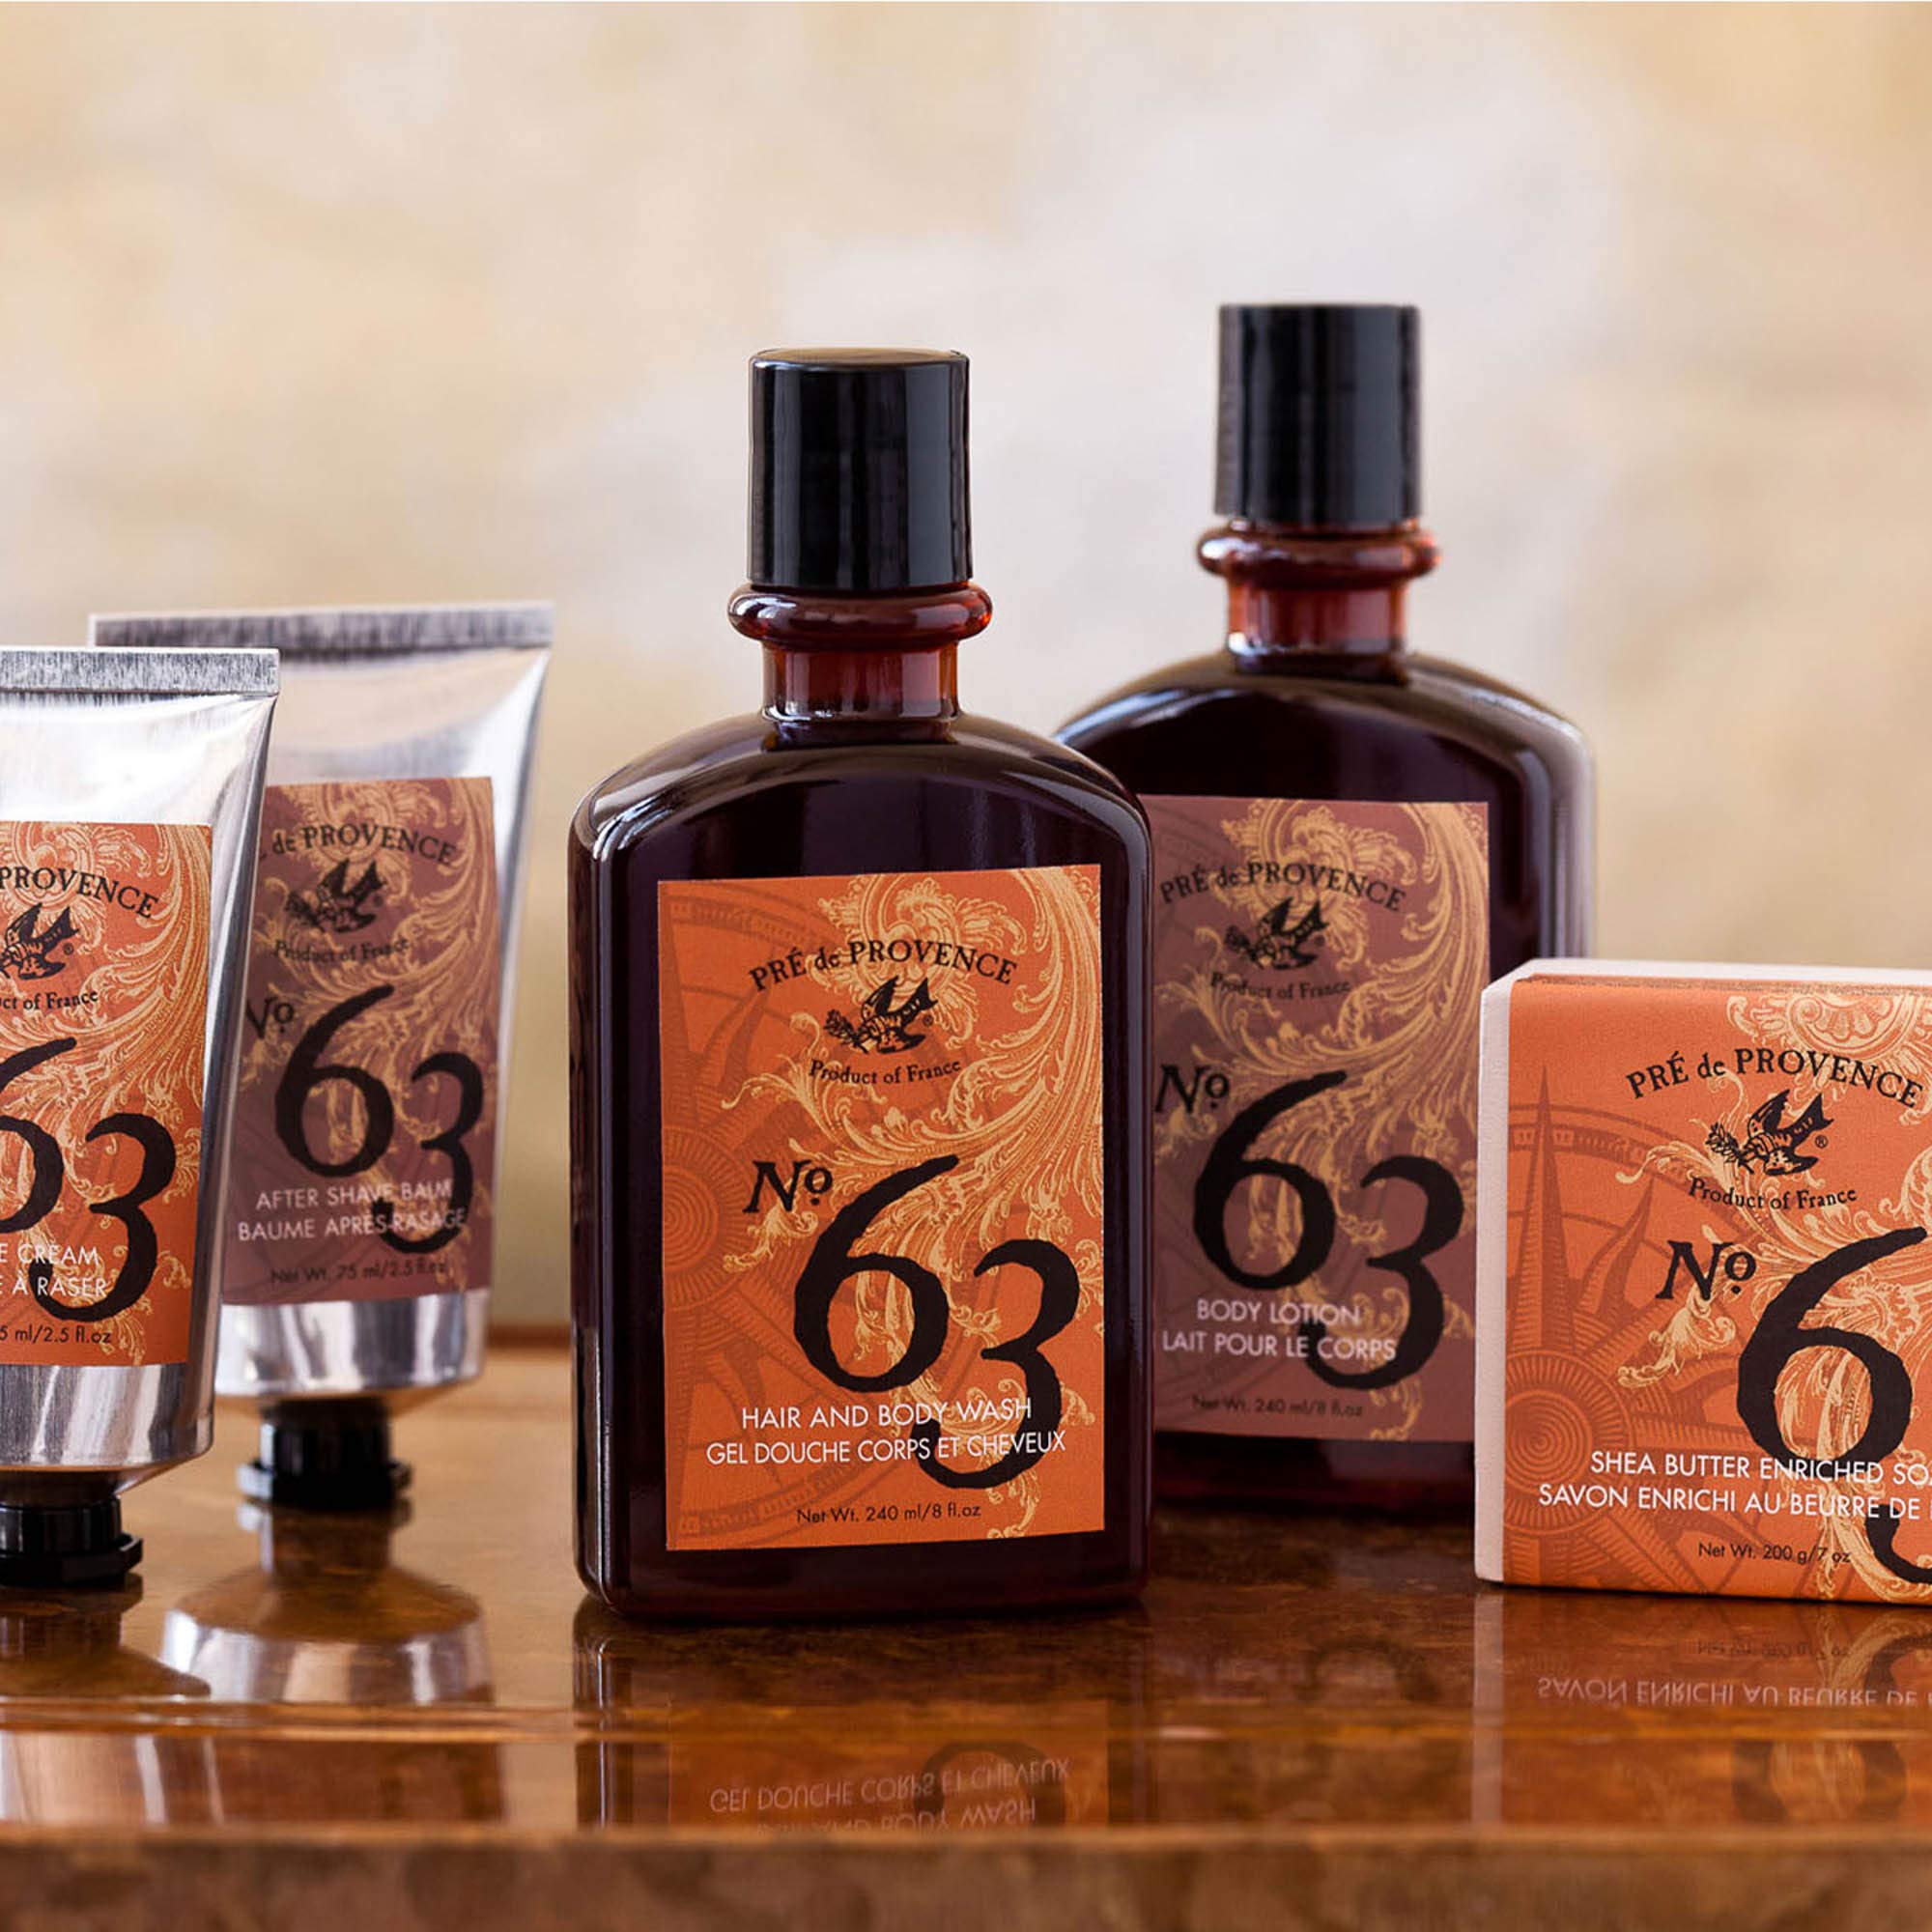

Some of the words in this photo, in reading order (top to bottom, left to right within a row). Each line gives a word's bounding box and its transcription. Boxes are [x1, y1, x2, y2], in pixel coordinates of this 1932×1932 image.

[271, 832, 296, 855] de
[302, 823, 458, 865] PROVENCE
[0, 867, 158, 919] PROVENCE
[1160, 864, 1208, 904] PRÉ
[1216, 867, 1239, 889] de
[1246, 860, 1407, 912] PROVENCE
[749, 948, 807, 992] PRÉ
[813, 947, 841, 971] de
[848, 939, 1018, 985] PROVENCE
[23, 992, 42, 1010] of
[46, 990, 99, 1009] France
[1210, 972, 1272, 1000] Product
[1278, 978, 1295, 1000] of
[809, 1059, 878, 1084] Product
[883, 1062, 902, 1084] of
[907, 1059, 962, 1082] France
[1625, 1051, 1690, 1099] PRÉ
[1697, 1053, 1727, 1078] de
[1734, 1047, 1924, 1109] PROVENCE
[274, 983, 483, 1255] 63
[256, 1186, 319, 1210] AFTER
[327, 1181, 393, 1207] SHAVE
[401, 1178, 452, 1202] BALM
[1689, 1177, 1766, 1209] Product
[1770, 1189, 1790, 1209] of
[1797, 1187, 1858, 1209] France
[238, 1218, 315, 1242] BAUME
[1192, 1069, 1464, 1391] 63
[17, 1243, 100, 1265] CREAM
[12, 1269, 28, 1295] À
[38, 1276, 107, 1298] RASER
[336, 1263, 356, 1280] 75
[794, 1154, 1081, 1490] 63
[1197, 1298, 1264, 1322] BODY
[1270, 1303, 1363, 1327] LOTION
[15, 1323, 71, 1344] ml/2.5
[1162, 1329, 1208, 1352] LAIT
[1214, 1332, 1278, 1356] POUR
[1286, 1336, 1309, 1358] LE
[1317, 1337, 1397, 1361] CORPS
[742, 1406, 802, 1430] HAIR
[810, 1405, 869, 1428] AND
[878, 1401, 950, 1426] BODY
[955, 1397, 1033, 1423] WASH
[1255, 1398, 1285, 1413] 240
[1737, 1226, 1932, 1584] 6
[706, 1442, 748, 1465] GEL
[754, 1438, 850, 1464] DOUCHE
[858, 1436, 931, 1462] CORPS
[938, 1435, 962, 1459] ET
[967, 1430, 1066, 1458] CHEVEUX
[1590, 1451, 1656, 1475] SHEA
[1665, 1453, 1750, 1479] BUTTER
[1760, 1457, 1884, 1485] ENRICHED
[1893, 1462, 1932, 1487] SO
[796, 1509, 827, 1523] Net
[830, 1507, 859, 1523] Wt.
[866, 1504, 898, 1522] 240
[904, 1503, 942, 1523] ml/8
[1539, 1483, 1628, 1508] SAVON
[1638, 1488, 1736, 1514] ENRICHI
[1744, 1492, 1781, 1515] AU
[1790, 1492, 1880, 1520] BEURRE
[1889, 1497, 1920, 1520] DE
[1698, 1542, 1725, 1558] Net
[1730, 1543, 1756, 1560] Wt.
[1762, 1545, 1793, 1561] 200
[1797, 1548, 1828, 1565] g/7
[1832, 1551, 1851, 1564] oz
